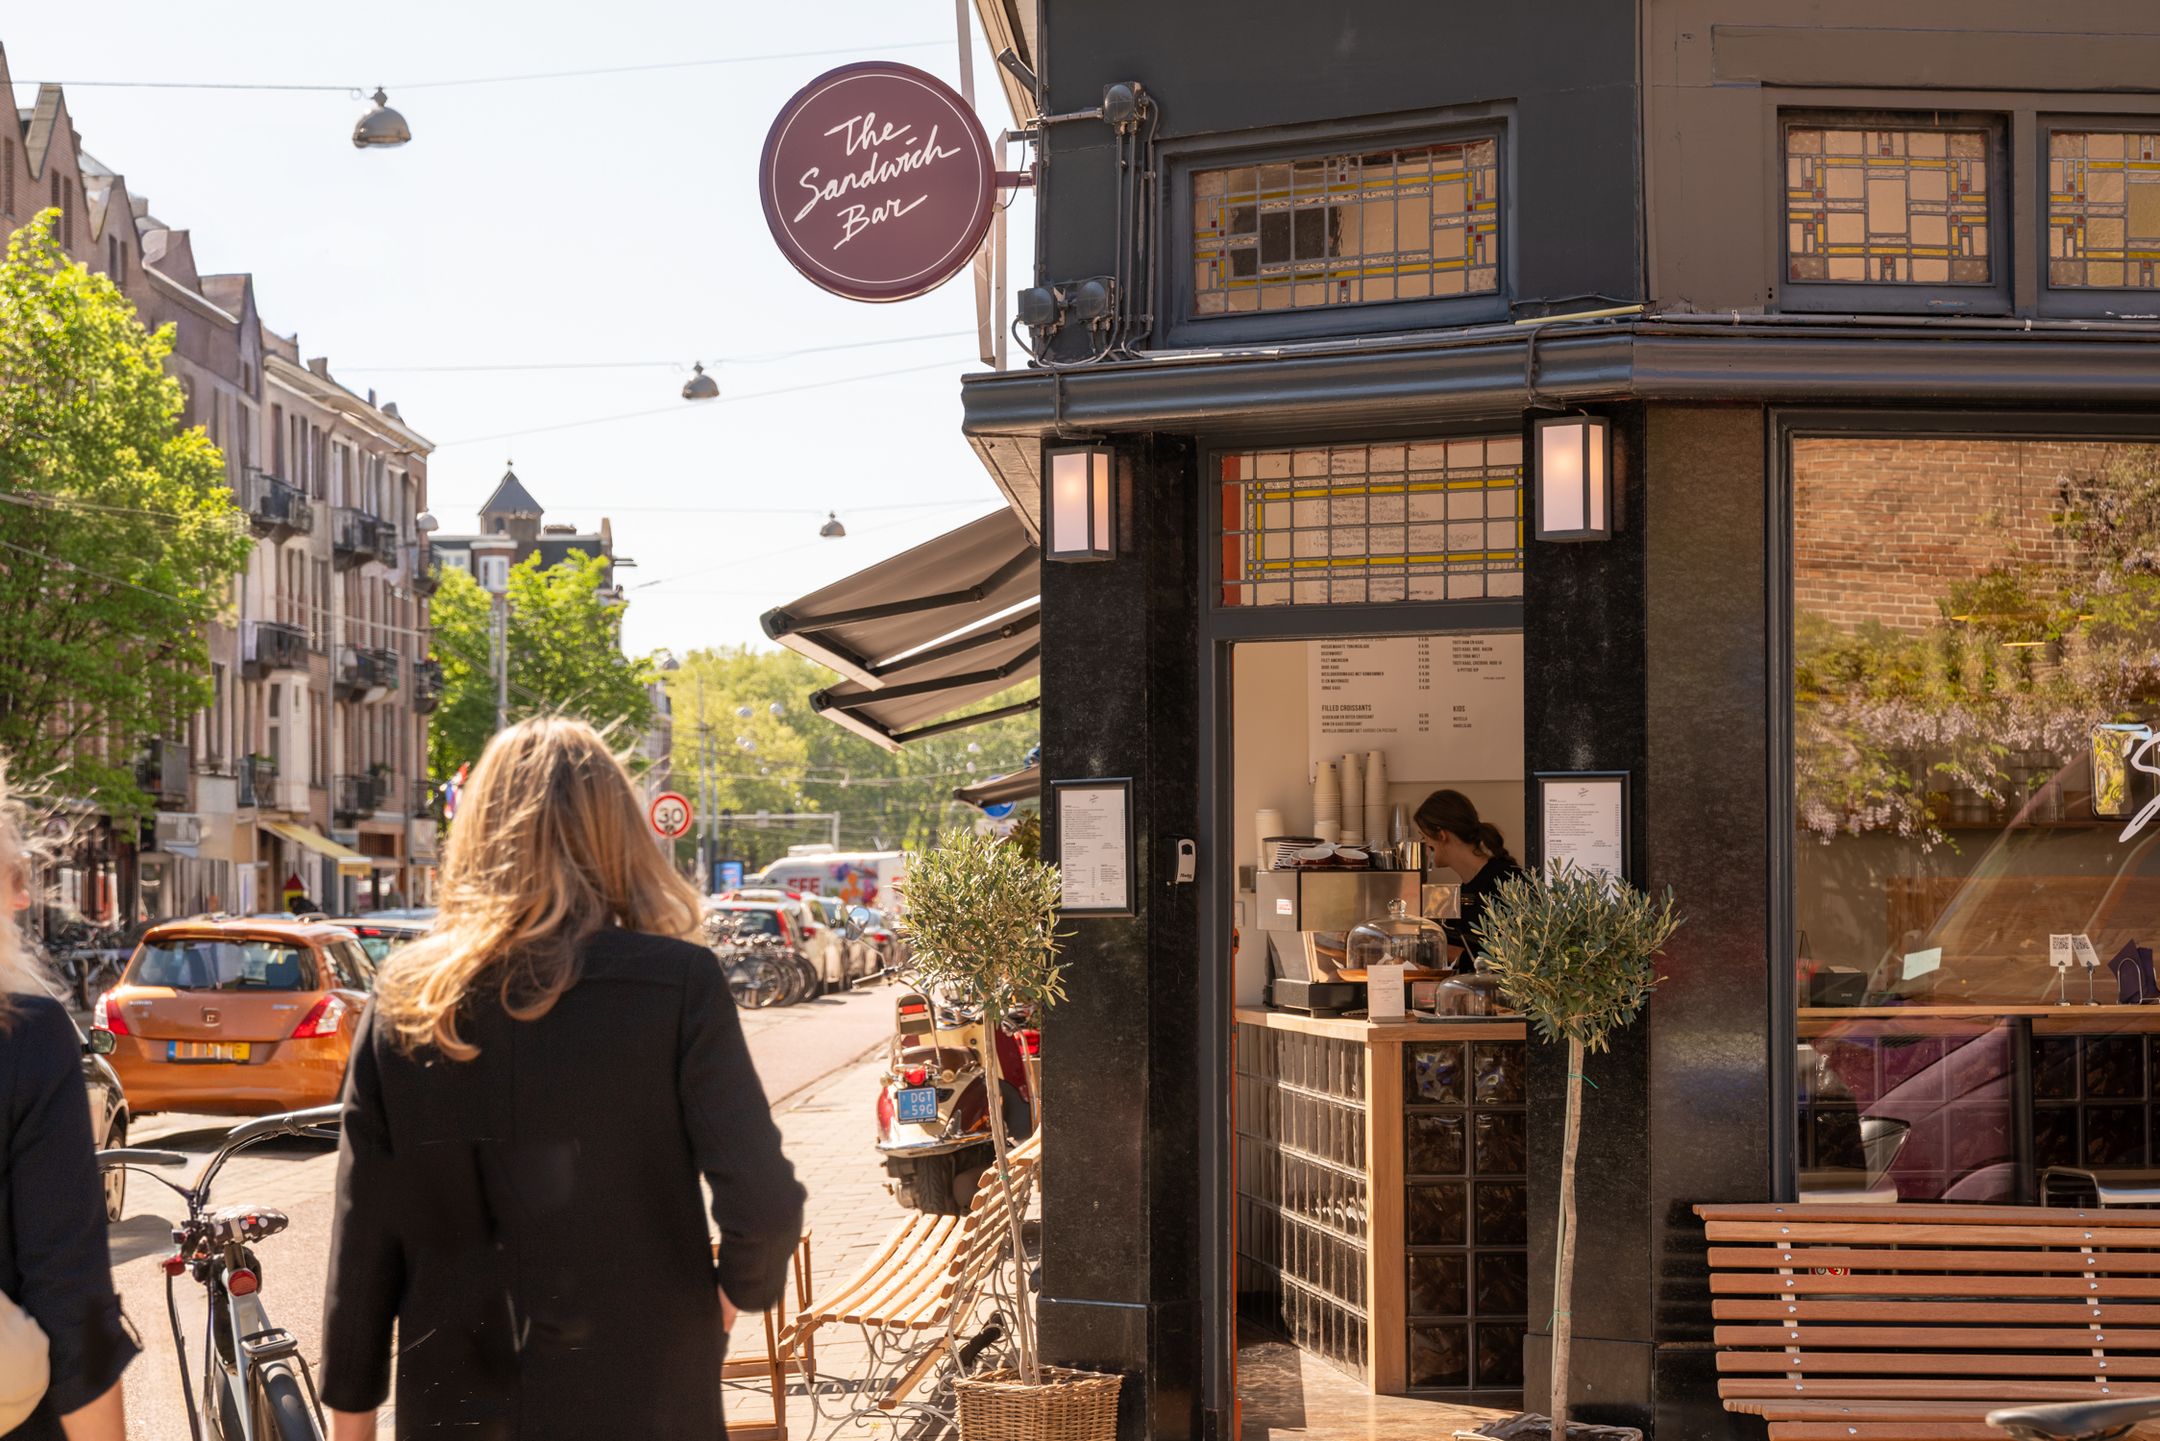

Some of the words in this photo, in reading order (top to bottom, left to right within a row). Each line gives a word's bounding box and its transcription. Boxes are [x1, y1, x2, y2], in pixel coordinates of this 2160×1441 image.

[824, 112, 911, 157] The
[794, 125, 961, 223] Sandwich
[833, 195, 928, 250] Bar
[1321, 704, 1339, 712] FILLED
[1340, 704, 1372, 712] CROISSANTS
[657, 806, 684, 824] 30
[911, 1091, 932, 1103] DGT
[911, 1103, 933, 1116] 59G
